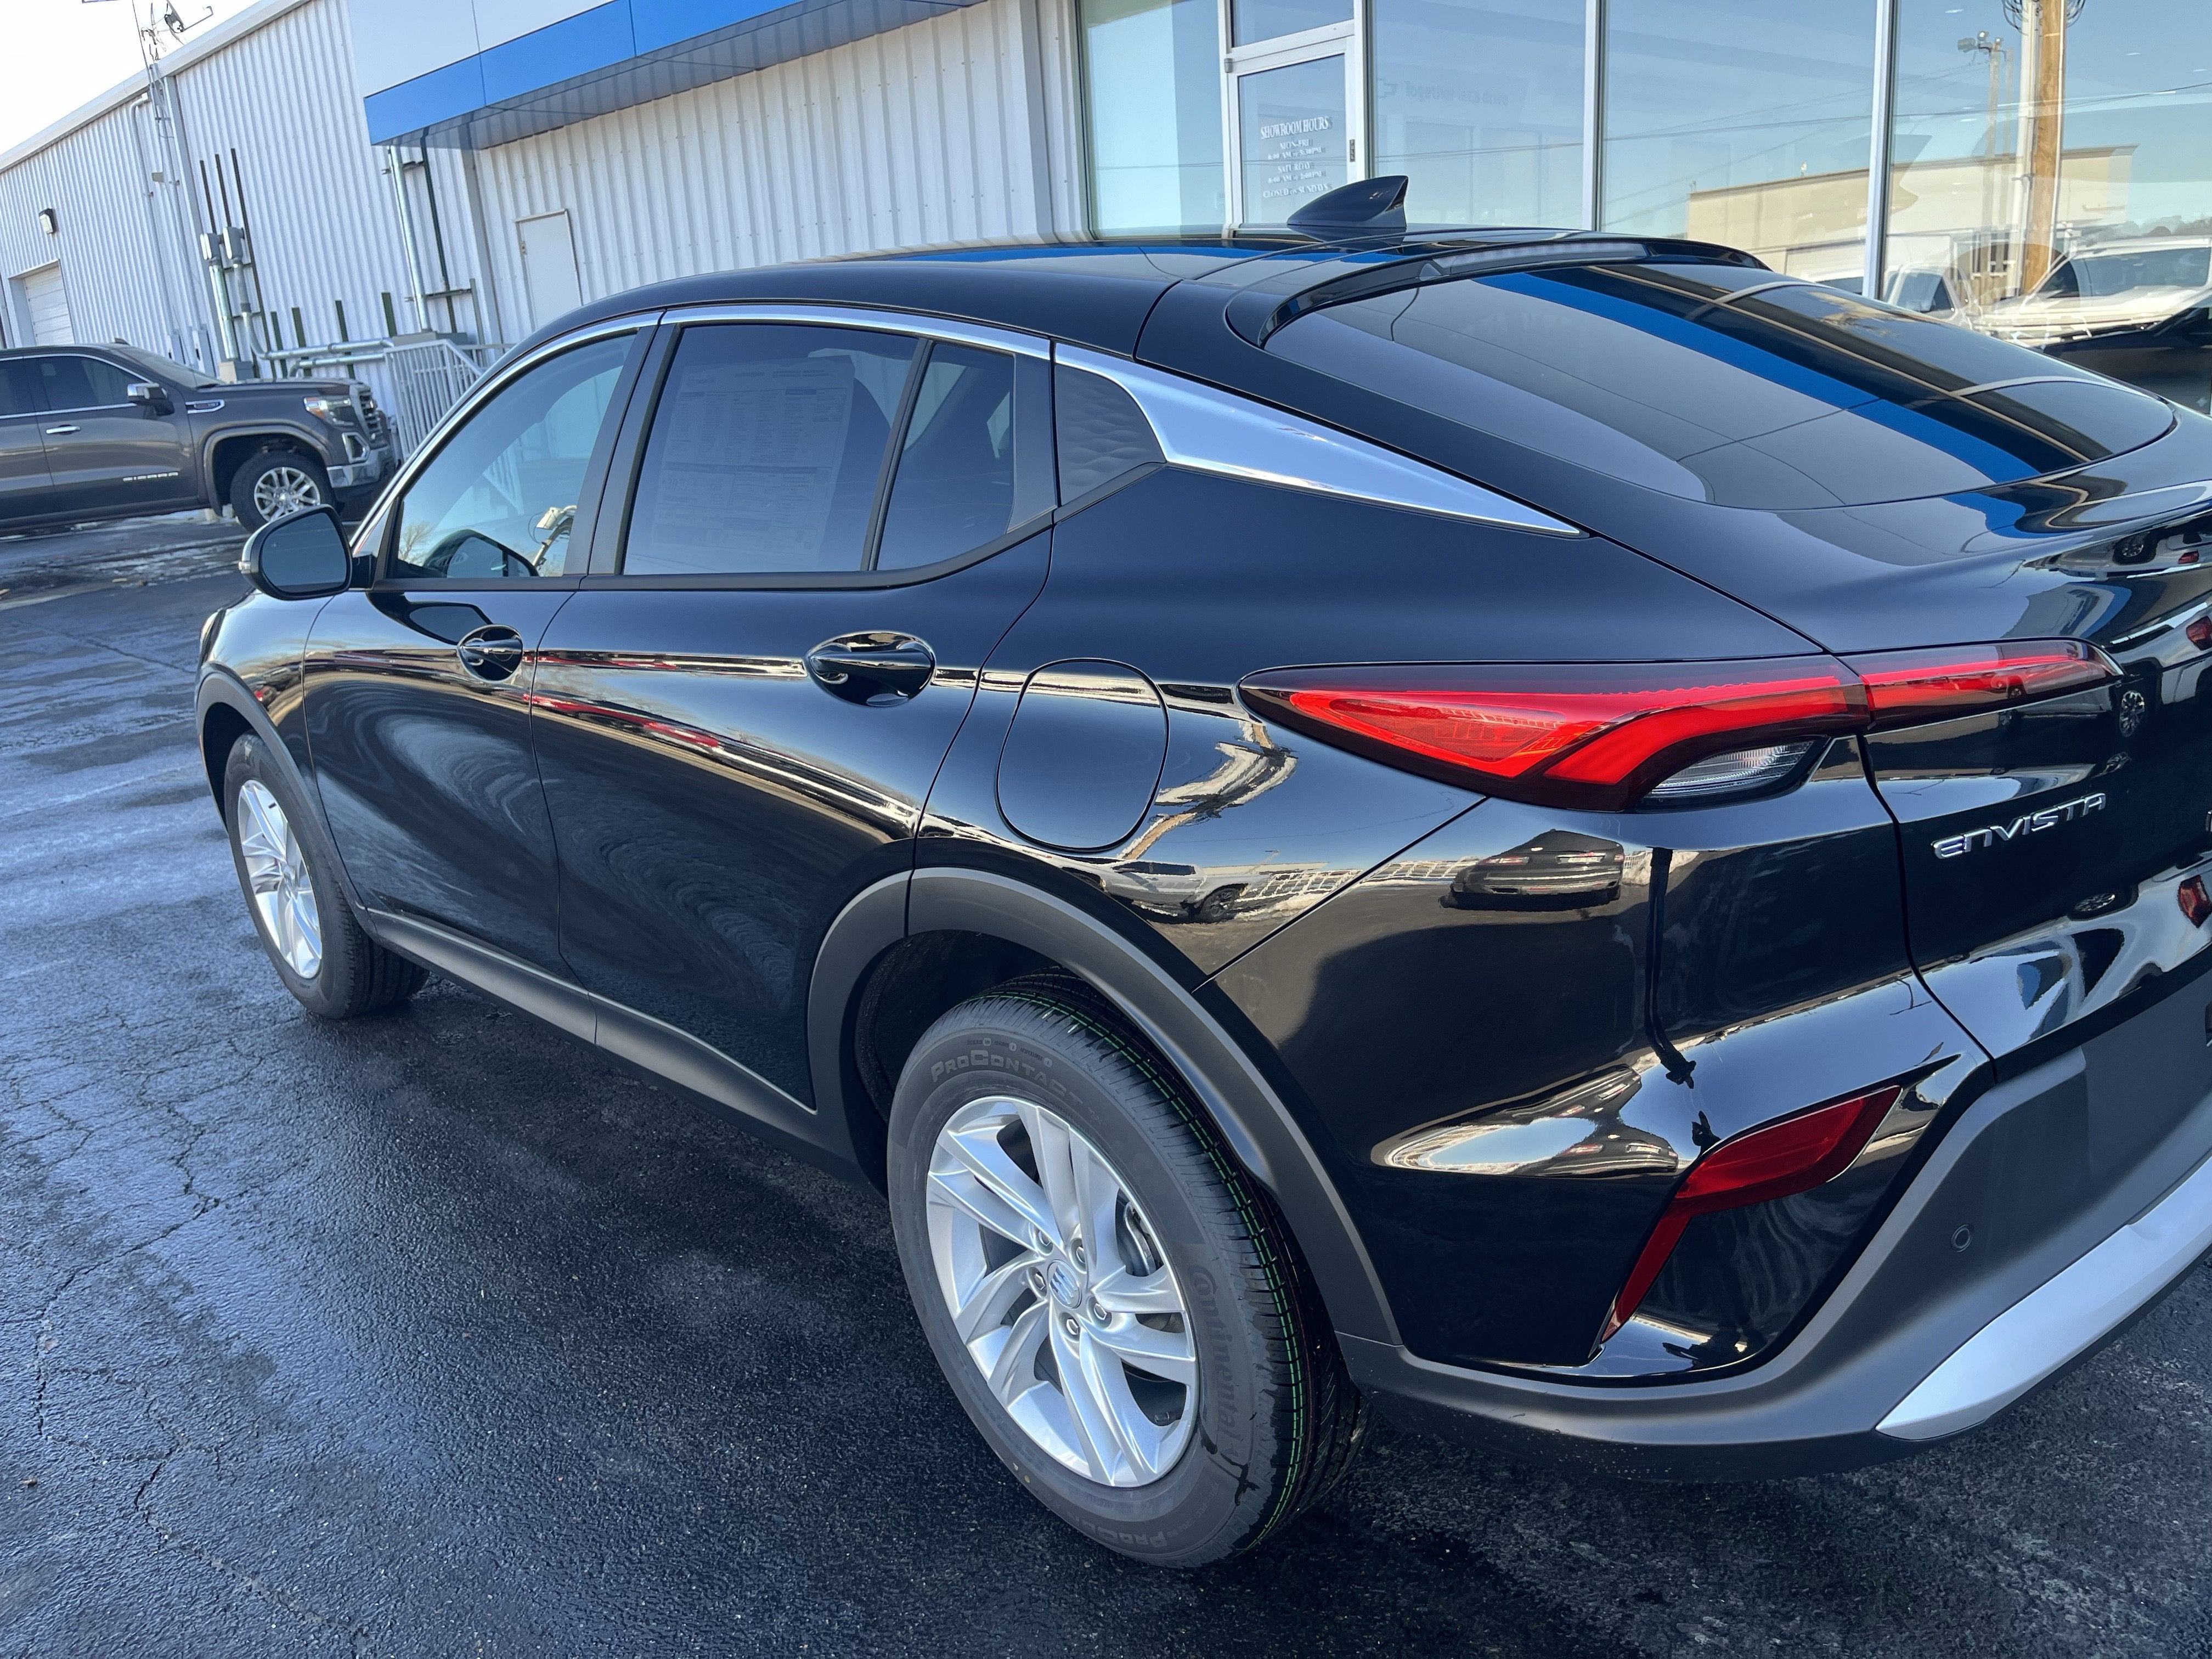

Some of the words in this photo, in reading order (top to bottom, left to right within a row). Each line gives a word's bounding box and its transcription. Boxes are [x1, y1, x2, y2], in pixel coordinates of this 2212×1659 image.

[1261, 120, 1302, 139] SHOWROOM
[1303, 116, 1329, 132] HOURS
[1278, 162, 1312, 173] SATURDAY
[1932, 792, 2106, 859] ENVISTA
[1187, 1265, 1241, 1442] Continental
